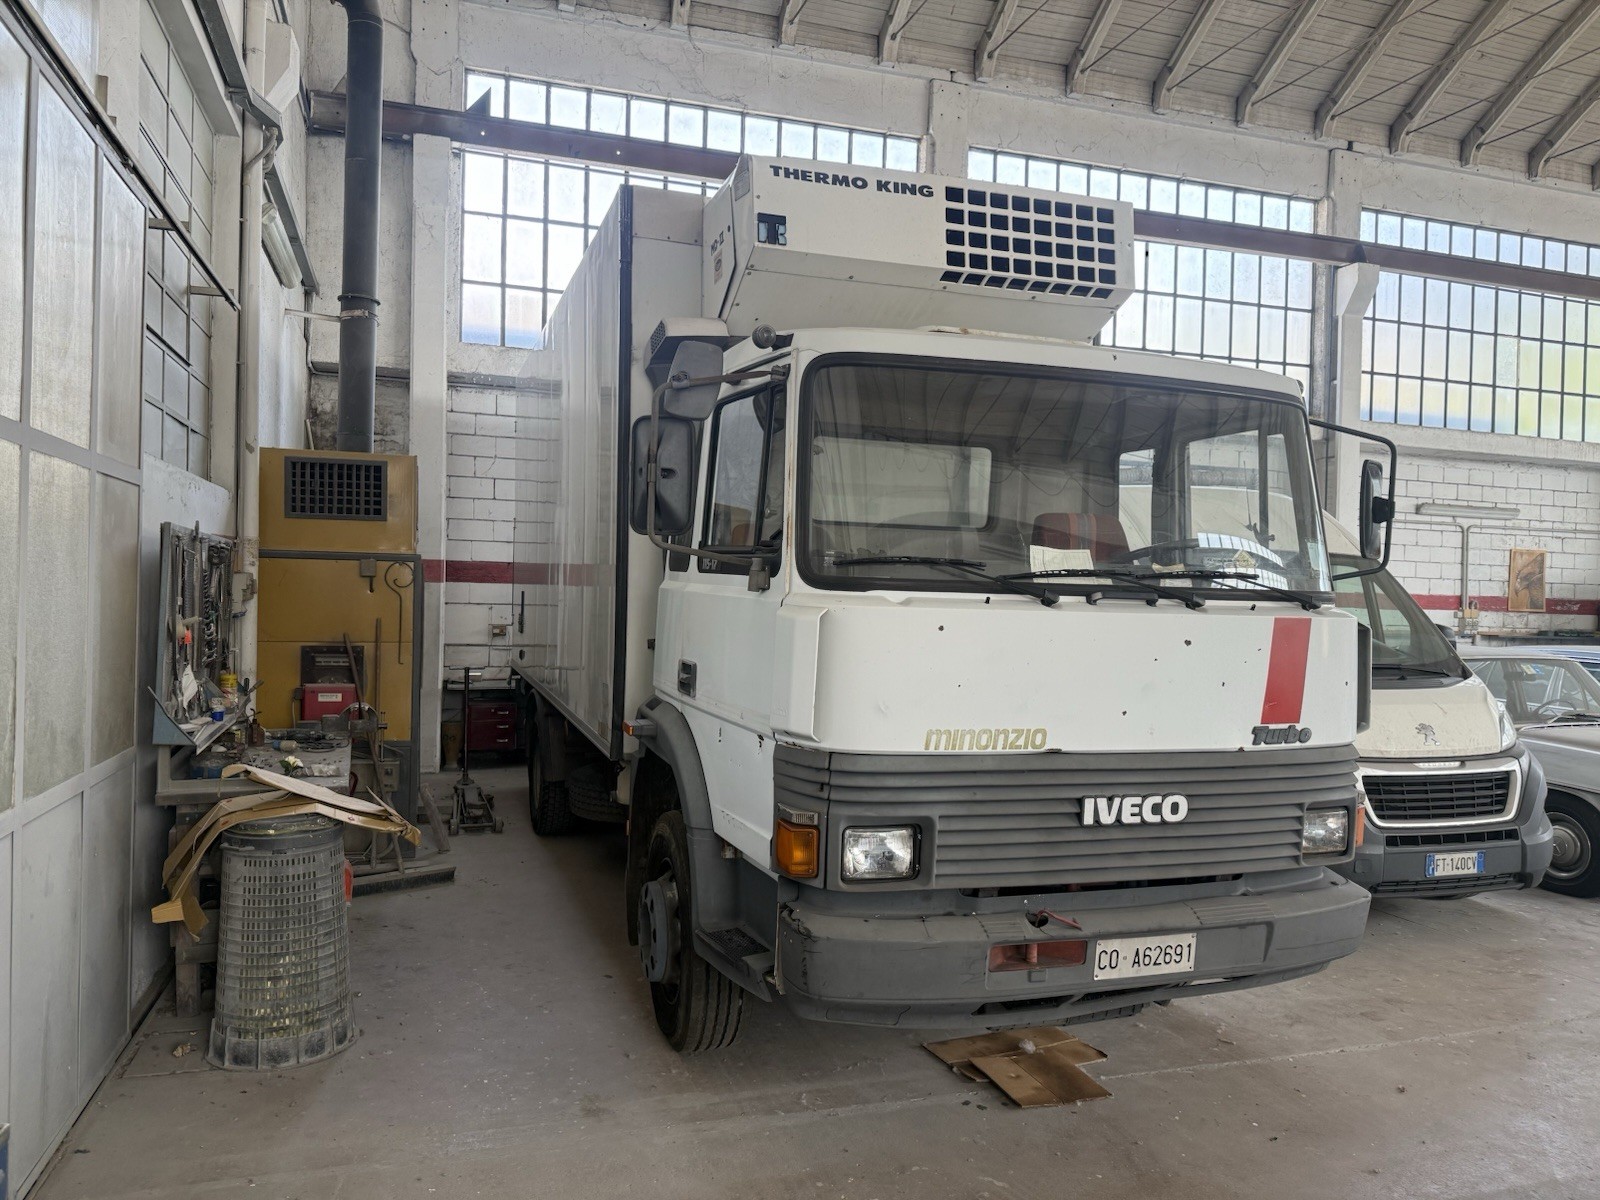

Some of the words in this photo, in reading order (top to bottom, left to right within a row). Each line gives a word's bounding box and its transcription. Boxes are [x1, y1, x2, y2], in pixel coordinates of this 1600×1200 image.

[769, 165, 868, 190] THERMO
[876, 180, 934, 198] KING
[924, 728, 1047, 751] minonzio
[1251, 725, 1312, 746] Turbo
[1082, 795, 1188, 825] IVECO
[1097, 948, 1120, 971] CO
[1131, 943, 1193, 970] A62691
